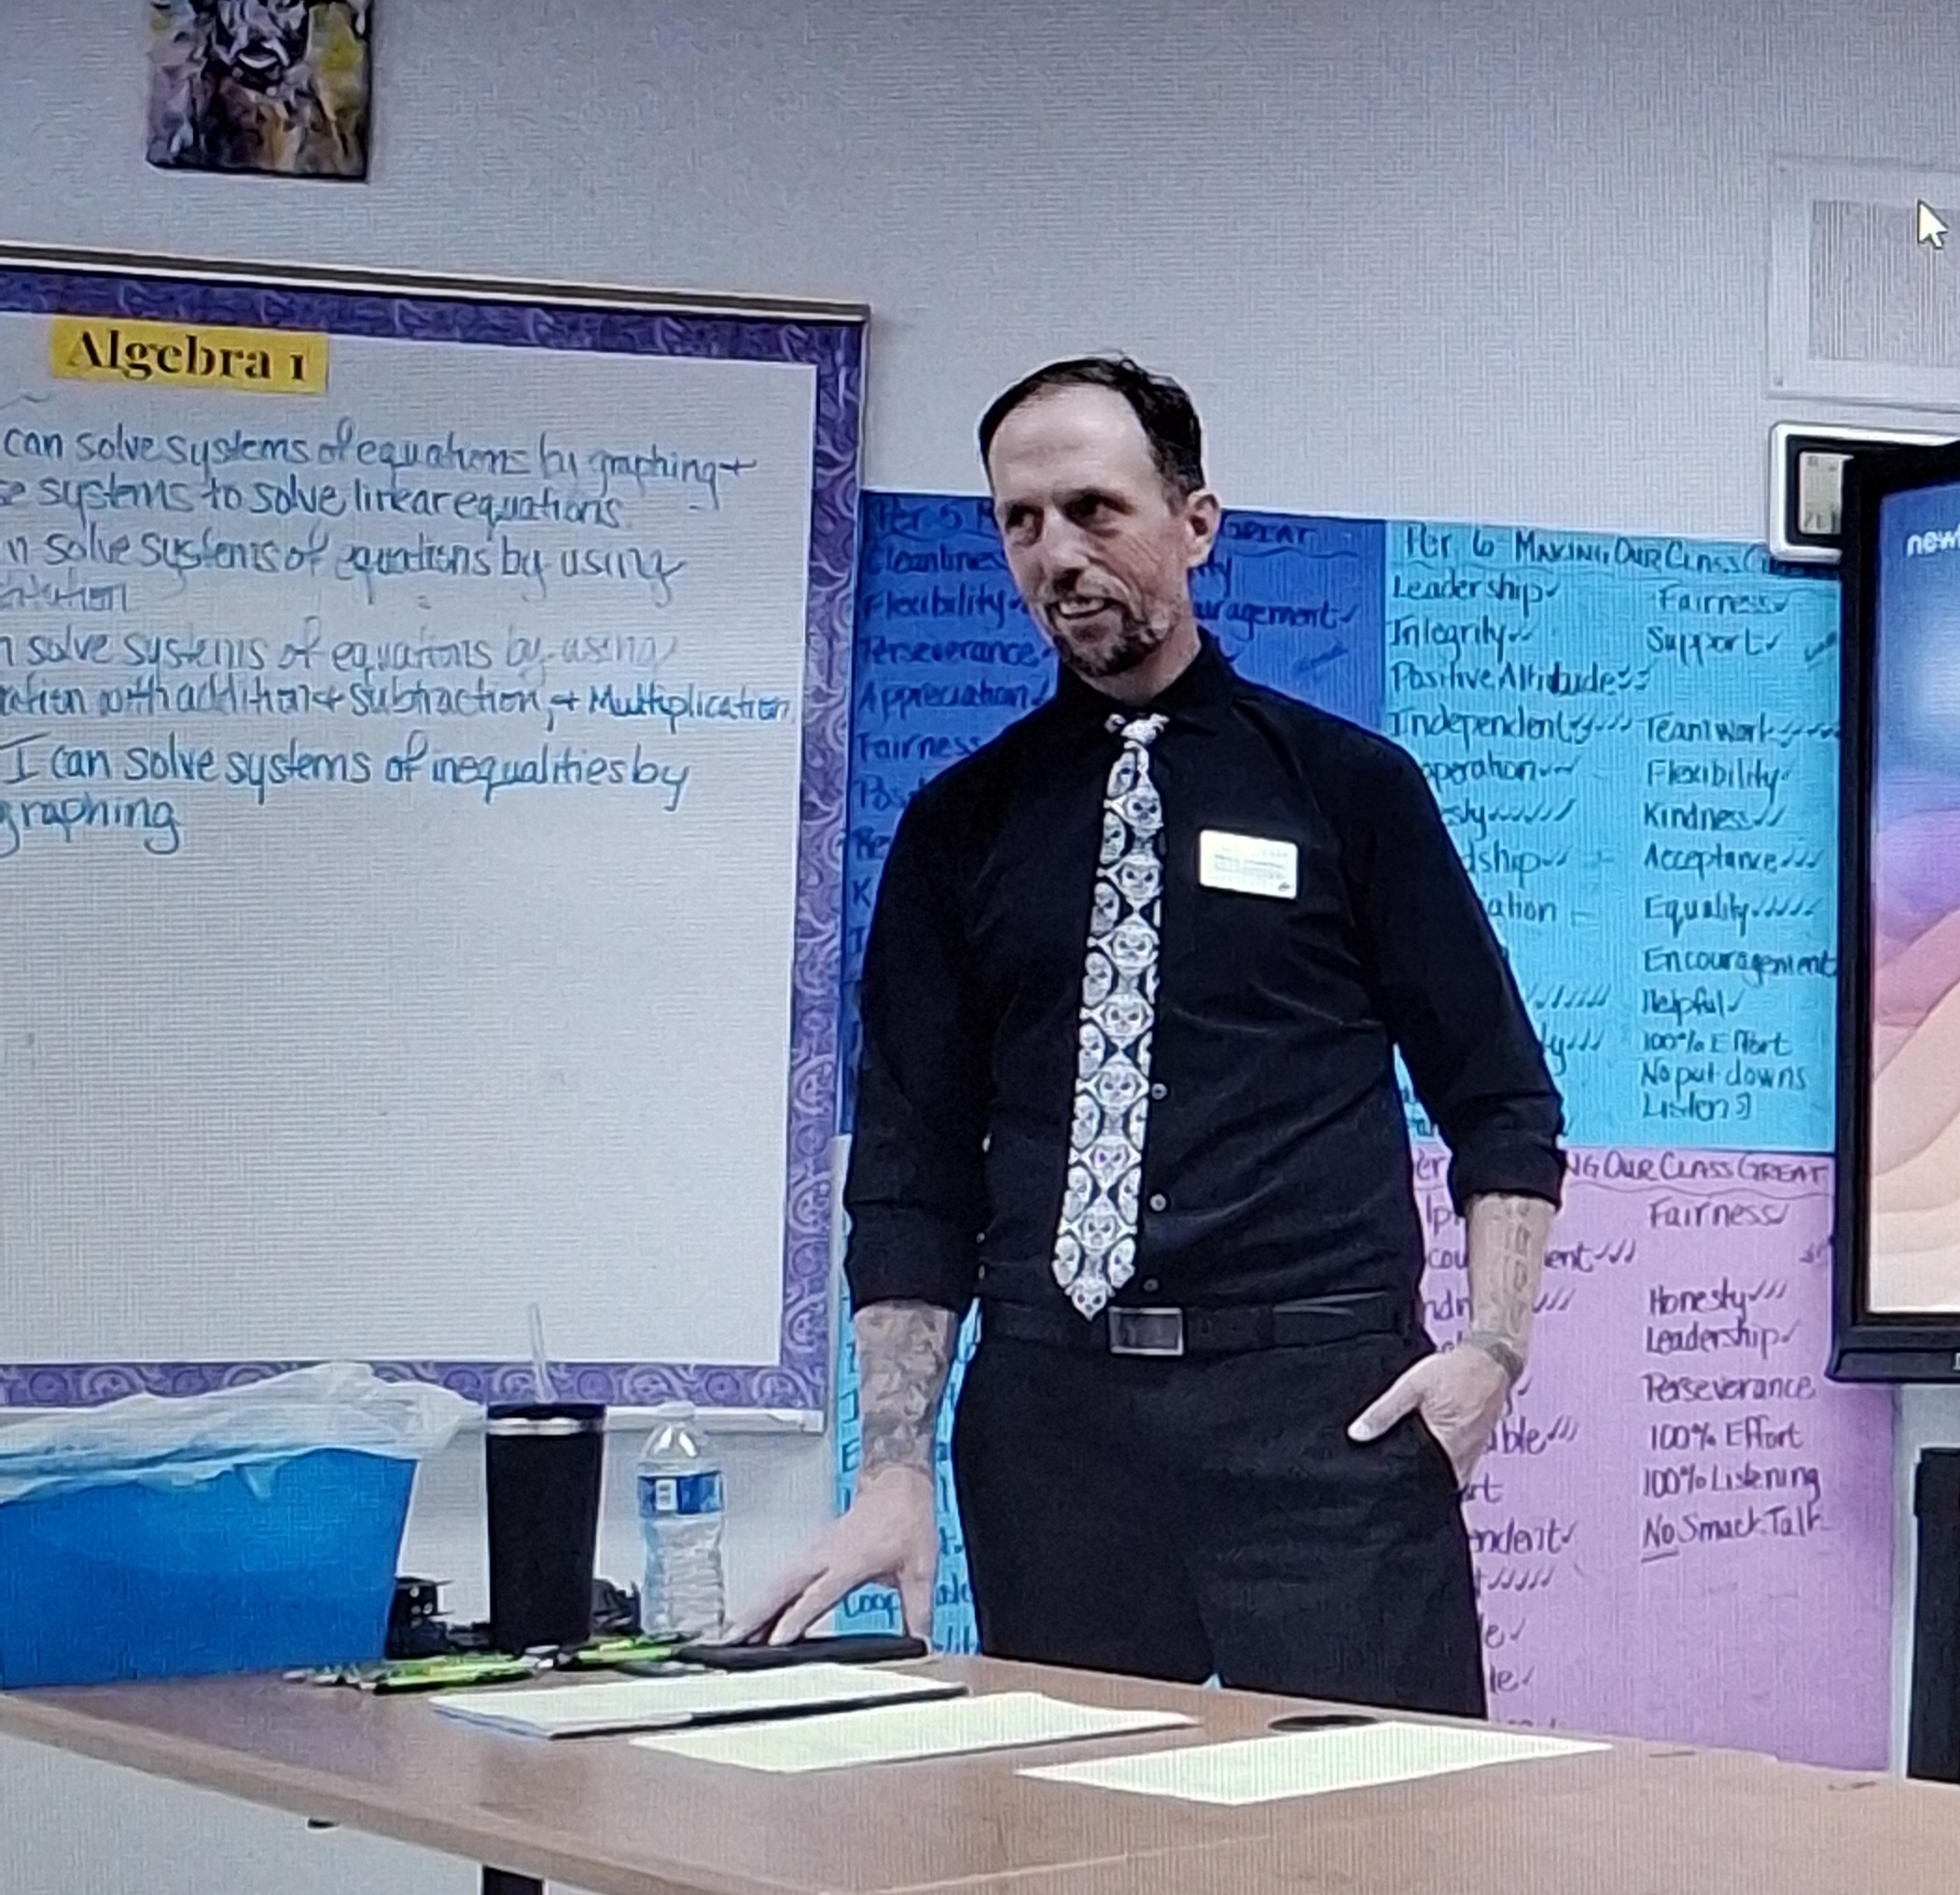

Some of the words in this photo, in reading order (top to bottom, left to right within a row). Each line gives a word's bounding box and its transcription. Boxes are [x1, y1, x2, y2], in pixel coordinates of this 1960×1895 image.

[67, 329, 272, 381] Algebra
[4, 428, 63, 459] can
[76, 423, 154, 463] solve
[164, 429, 312, 480] systems
[38, 477, 195, 530] systems
[201, 478, 243, 510] to
[249, 474, 348, 517] solve
[453, 487, 623, 541] equations
[1392, 566, 1543, 620] Leadership
[28, 624, 111, 667] solve
[1388, 614, 1508, 664] Integrity
[1647, 625, 1761, 668] Support
[51, 745, 112, 780] can
[123, 731, 219, 782] solve
[224, 737, 373, 806] systems
[383, 729, 430, 783] of
[431, 743, 627, 806] inequalities
[629, 743, 691, 813] by
[1647, 758, 1780, 806] Flexibility
[1644, 801, 1755, 832] Kindness
[1644, 842, 1778, 881] Acceptance
[1645, 889, 1750, 939] Equality
[1645, 947, 1837, 987] Encouragement
[1726, 1057, 1807, 1092] downs
[1661, 1150, 1734, 1181] CLASS
[1649, 1195, 1777, 1228] Fairness
[1649, 1275, 1746, 1323] Honesty
[1646, 1317, 1782, 1360] Leadership
[1642, 1372, 1817, 1404] Perseverance
[1651, 1422, 1717, 1451] 100%
[1726, 1414, 1804, 1450] Effort
[1644, 1463, 1706, 1498] 100%
[1642, 1513, 1675, 1549] No
